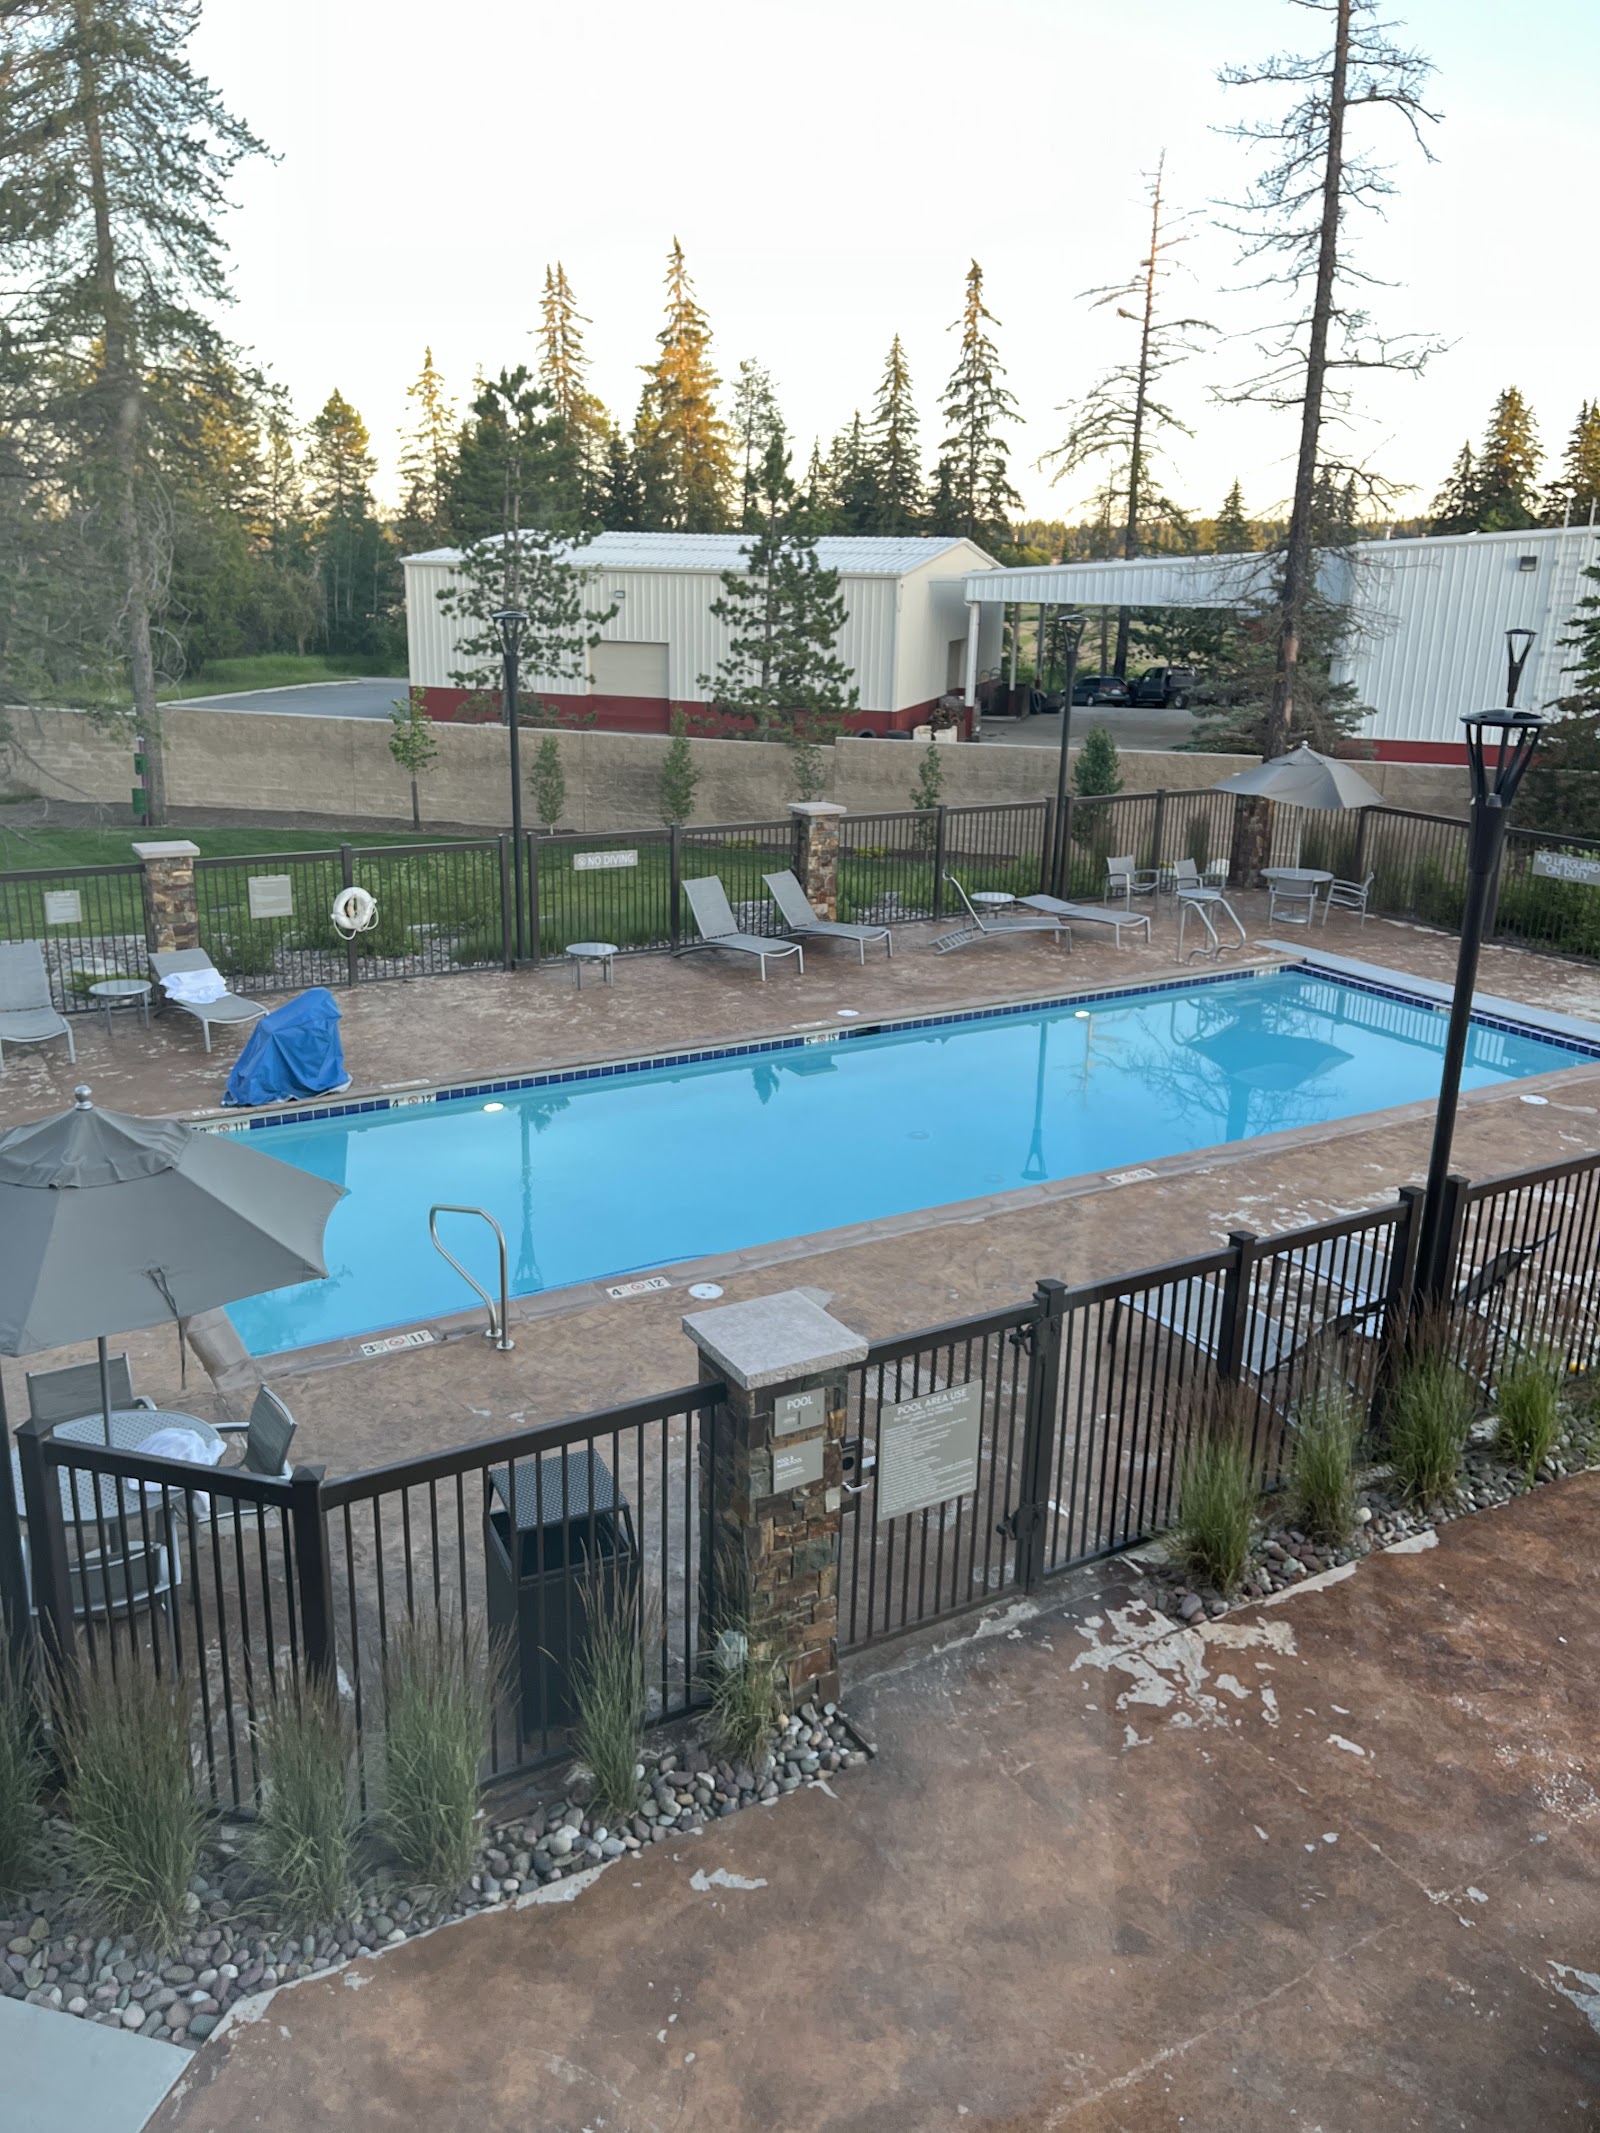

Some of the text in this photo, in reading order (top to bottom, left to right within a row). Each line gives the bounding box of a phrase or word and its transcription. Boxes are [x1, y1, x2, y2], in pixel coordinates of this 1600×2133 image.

[587, 853, 635, 866] NO DIVING
[1537, 854, 1600, 874] NO LIFEGUARD
[1545, 865, 1590, 880] ON DUTY
[786, 1395, 814, 1410] POOL
[897, 1387, 967, 1416] POOL AREA USE
